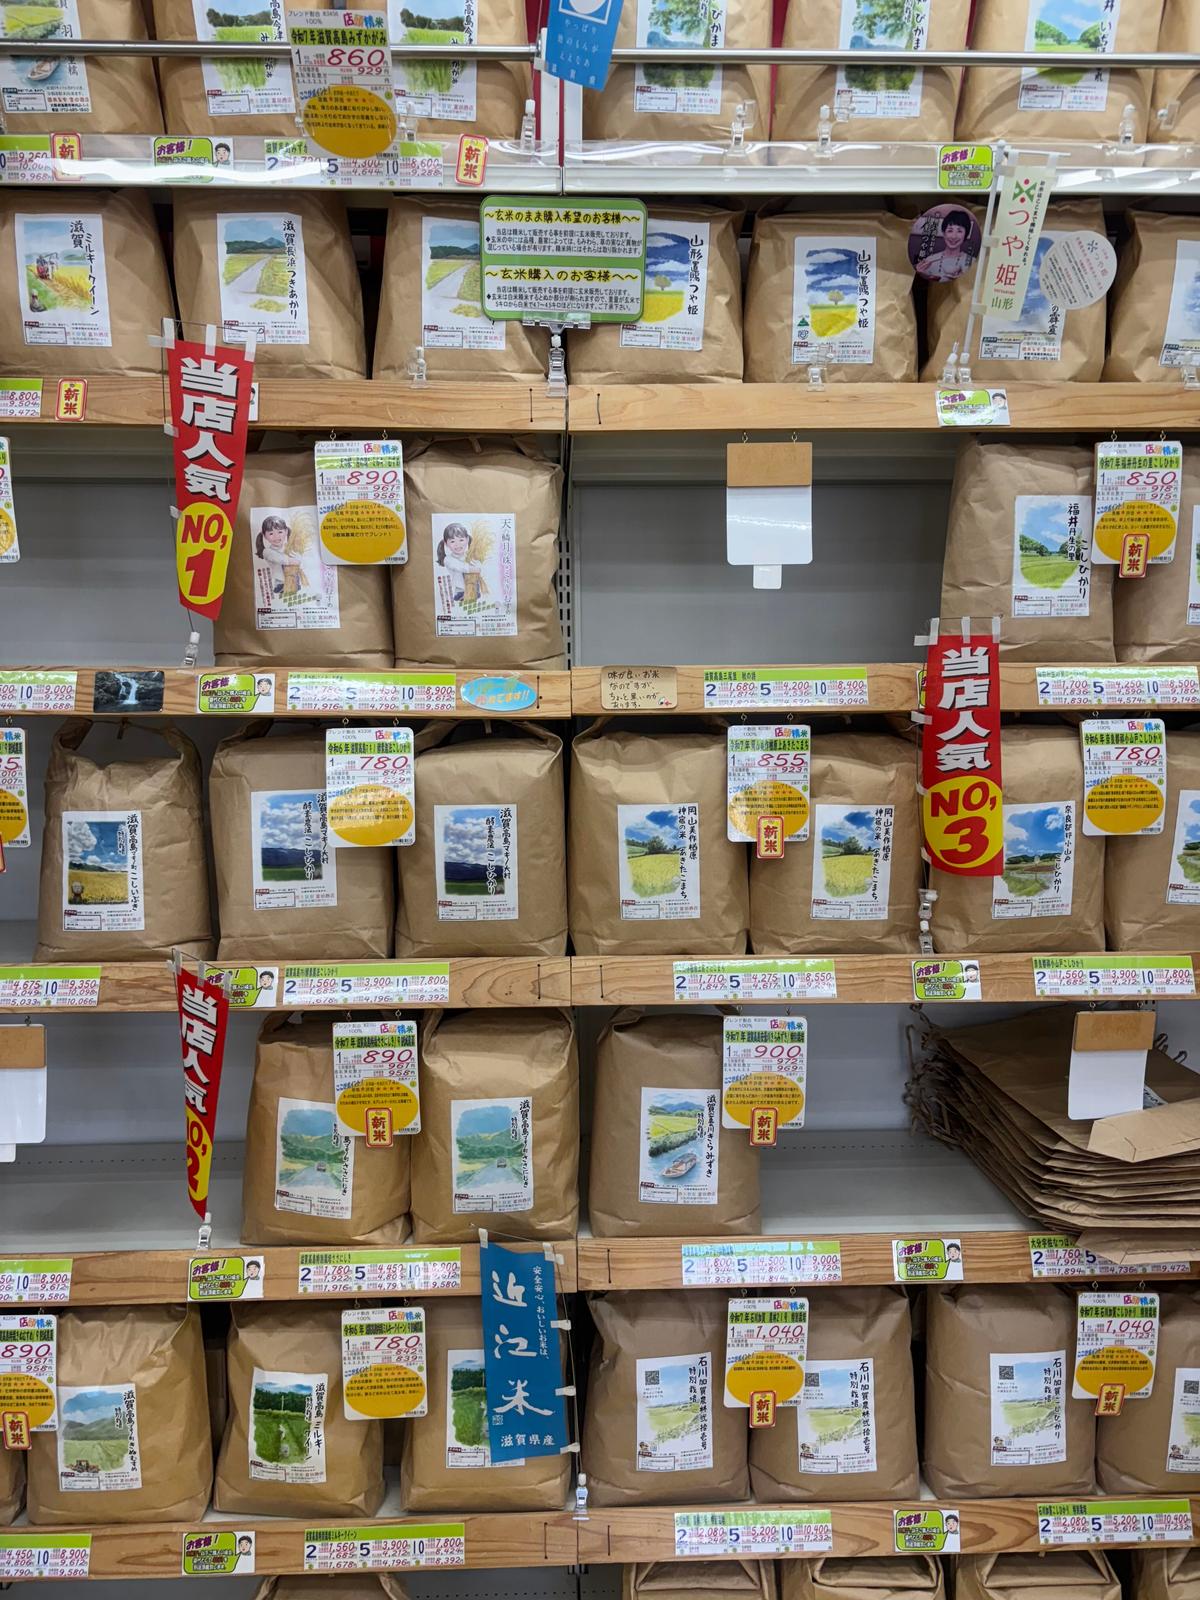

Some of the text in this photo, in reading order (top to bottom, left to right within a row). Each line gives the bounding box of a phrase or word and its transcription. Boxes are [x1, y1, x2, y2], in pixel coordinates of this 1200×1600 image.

[327, 48, 385, 67] 860
[357, 66, 383, 76] 929
[327, 158, 439, 174] 5 4,300 10 8,600
[463, 145, 482, 181] 新米
[70, 220, 85, 248] 滋賀
[996, 210, 1030, 287] つや姫
[85, 233, 99, 315] ミルキークイーン
[283, 220, 299, 320] 滋賀長浜つきあかり
[486, 268, 638, 283] 〜玄米購入のお客様へ〜
[991, 296, 1014, 309] 山形
[9, 392, 38, 400] 8,800
[64, 388, 80, 416] 新米
[180, 357, 239, 503] 当店人気
[347, 470, 398, 485] 890
[1126, 471, 1176, 486] 850
[1068, 503, 1080, 562] 福井丹生の里
[1128, 543, 1141, 572] 新米
[185, 548, 215, 598] 1
[1077, 540, 1089, 599] こしひかり
[20, 685, 71, 699] 10 9,000
[706, 681, 864, 696] 2 1,680 4,200 8,400
[1062, 680, 1195, 689] 1,700 4,250 8,500
[402, 687, 452, 699] 10 8,900
[936, 647, 992, 772] 当店人気
[757, 753, 806, 767] 855
[1114, 746, 1161, 761] 780
[359, 755, 409, 770] 780
[781, 766, 802, 774] 923
[763, 825, 778, 853] 新米
[939, 816, 989, 866] 3
[1053, 855, 1062, 894] こしひかり
[309, 976, 445, 987] 1,560 3,900 7,800
[698, 973, 831, 983] 1,710 4,275 8,550
[1058, 969, 1189, 979] 1,560 3,900 7,800
[13, 980, 96, 989] 4,675 9,350
[363, 1049, 413, 1063] 890
[754, 1045, 802, 1058] 900
[371, 1117, 386, 1142] 新米
[757, 1116, 771, 1141] 新米
[812, 1255, 837, 1264] 9,000
[1054, 1249, 1080, 1258] 1,760
[323, 1266, 349, 1274] 1,780
[40, 1274, 67, 1283] 8,900
[39, 1293, 64, 1301] 9,580
[532, 1265, 550, 1360] 安全安心、おいしいお米は、
[756, 1325, 803, 1338] 1,040
[1105, 1319, 1153, 1333] 1,040
[373, 1335, 420, 1350] 780
[492, 1270, 556, 1416] 近江米
[1, 1344, 51, 1358] 890
[688, 1367, 697, 1403] 特別栽培
[849, 1371, 859, 1408] 特別栽培
[1043, 1367, 1051, 1403] 特別栽培
[1052, 1357, 1062, 1439] 石川加賀こしひかり
[1103, 1390, 1118, 1412] 新米
[313, 1382, 326, 1456] 滋賀高島 ミルキー
[756, 1400, 770, 1423] 新米
[8, 1419, 25, 1445] 新米
[304, 1430, 312, 1461] クイーン
[501, 1432, 556, 1448] 滋賀県産
[1062, 1514, 1188, 1526] 2,080 5,200 10,400
[751, 1525, 828, 1535] 5,200 10,400
[328, 1539, 460, 1551] 1,560 3,900 7,800
[7, 1550, 85, 1559] 4,450 8,900
